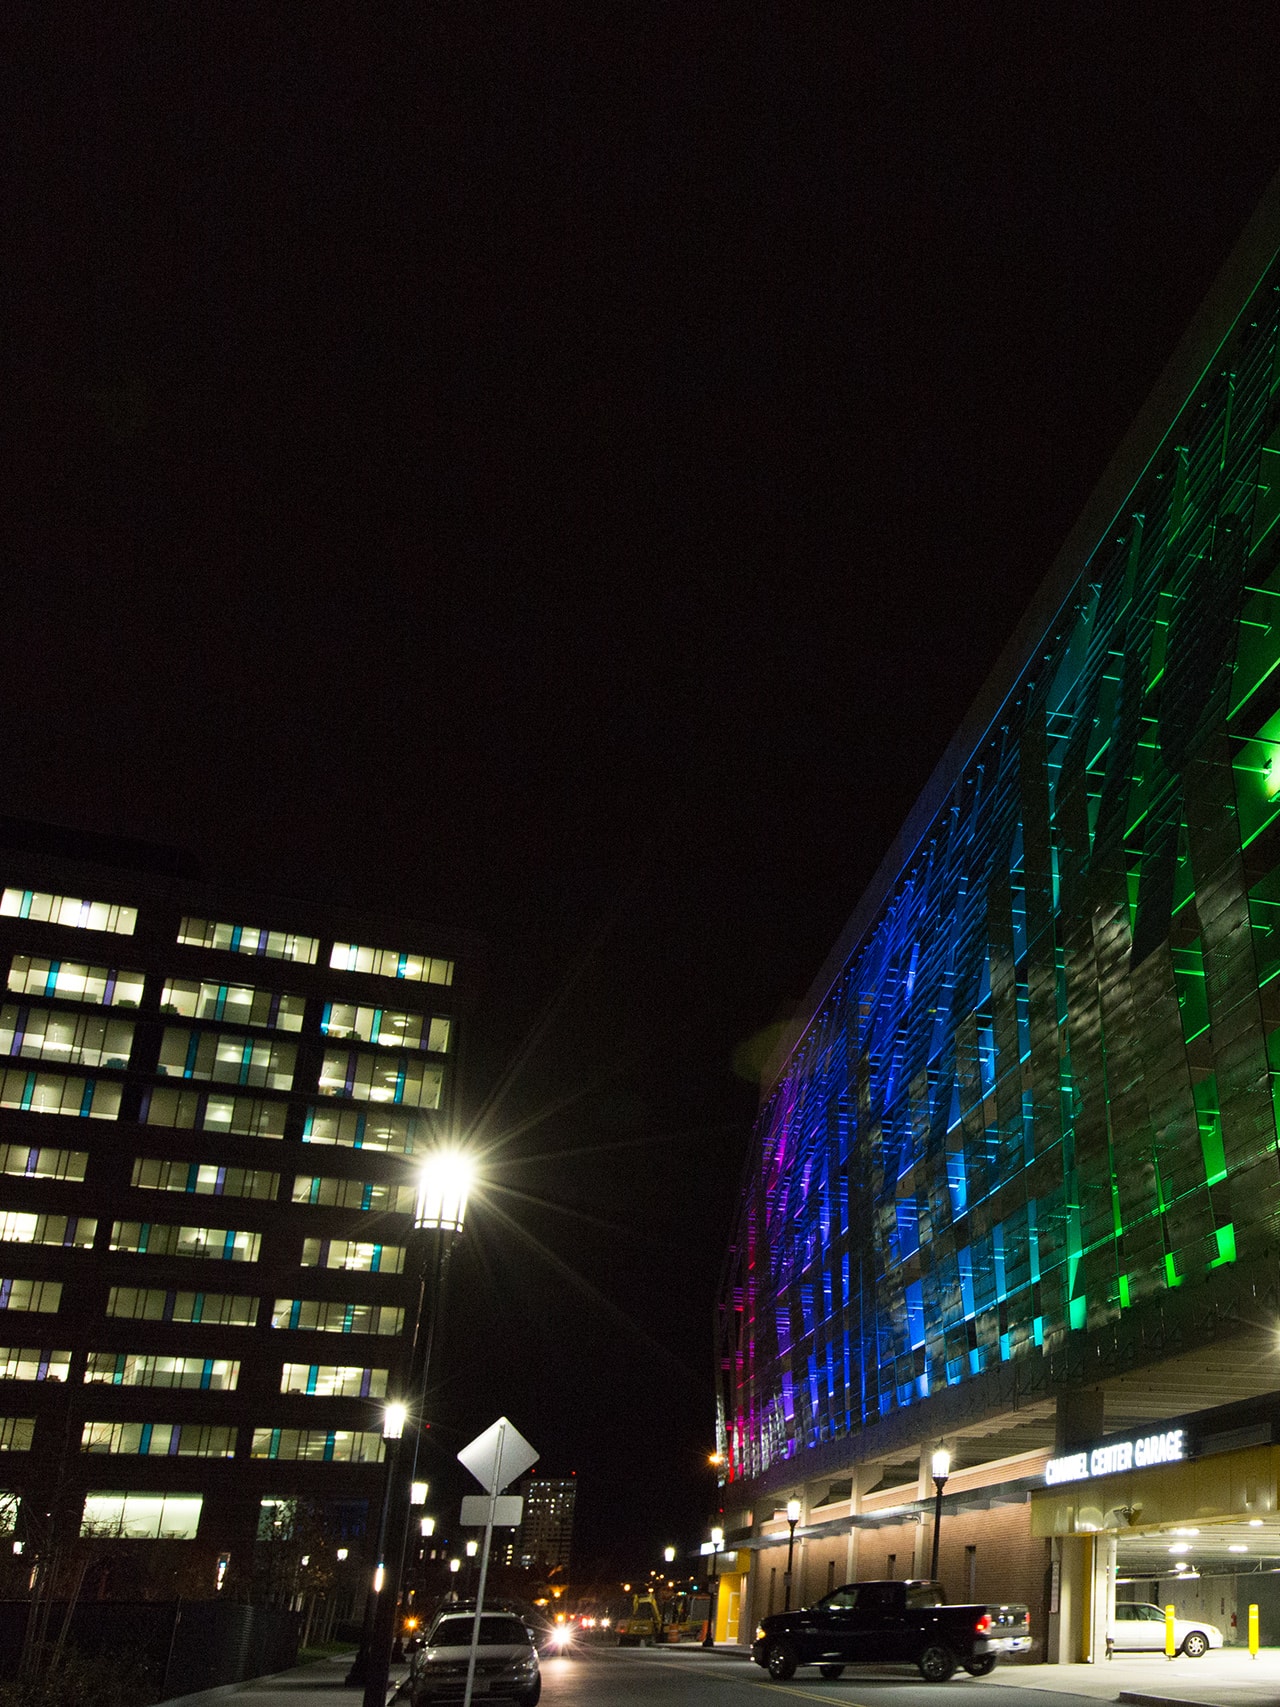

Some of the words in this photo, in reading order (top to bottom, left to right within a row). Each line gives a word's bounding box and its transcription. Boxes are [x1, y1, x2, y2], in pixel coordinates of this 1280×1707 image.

[1046, 1452, 1089, 1485] CHANNEL
[1091, 1442, 1133, 1476] CENTER
[1135, 1429, 1183, 1467] GARAGE
